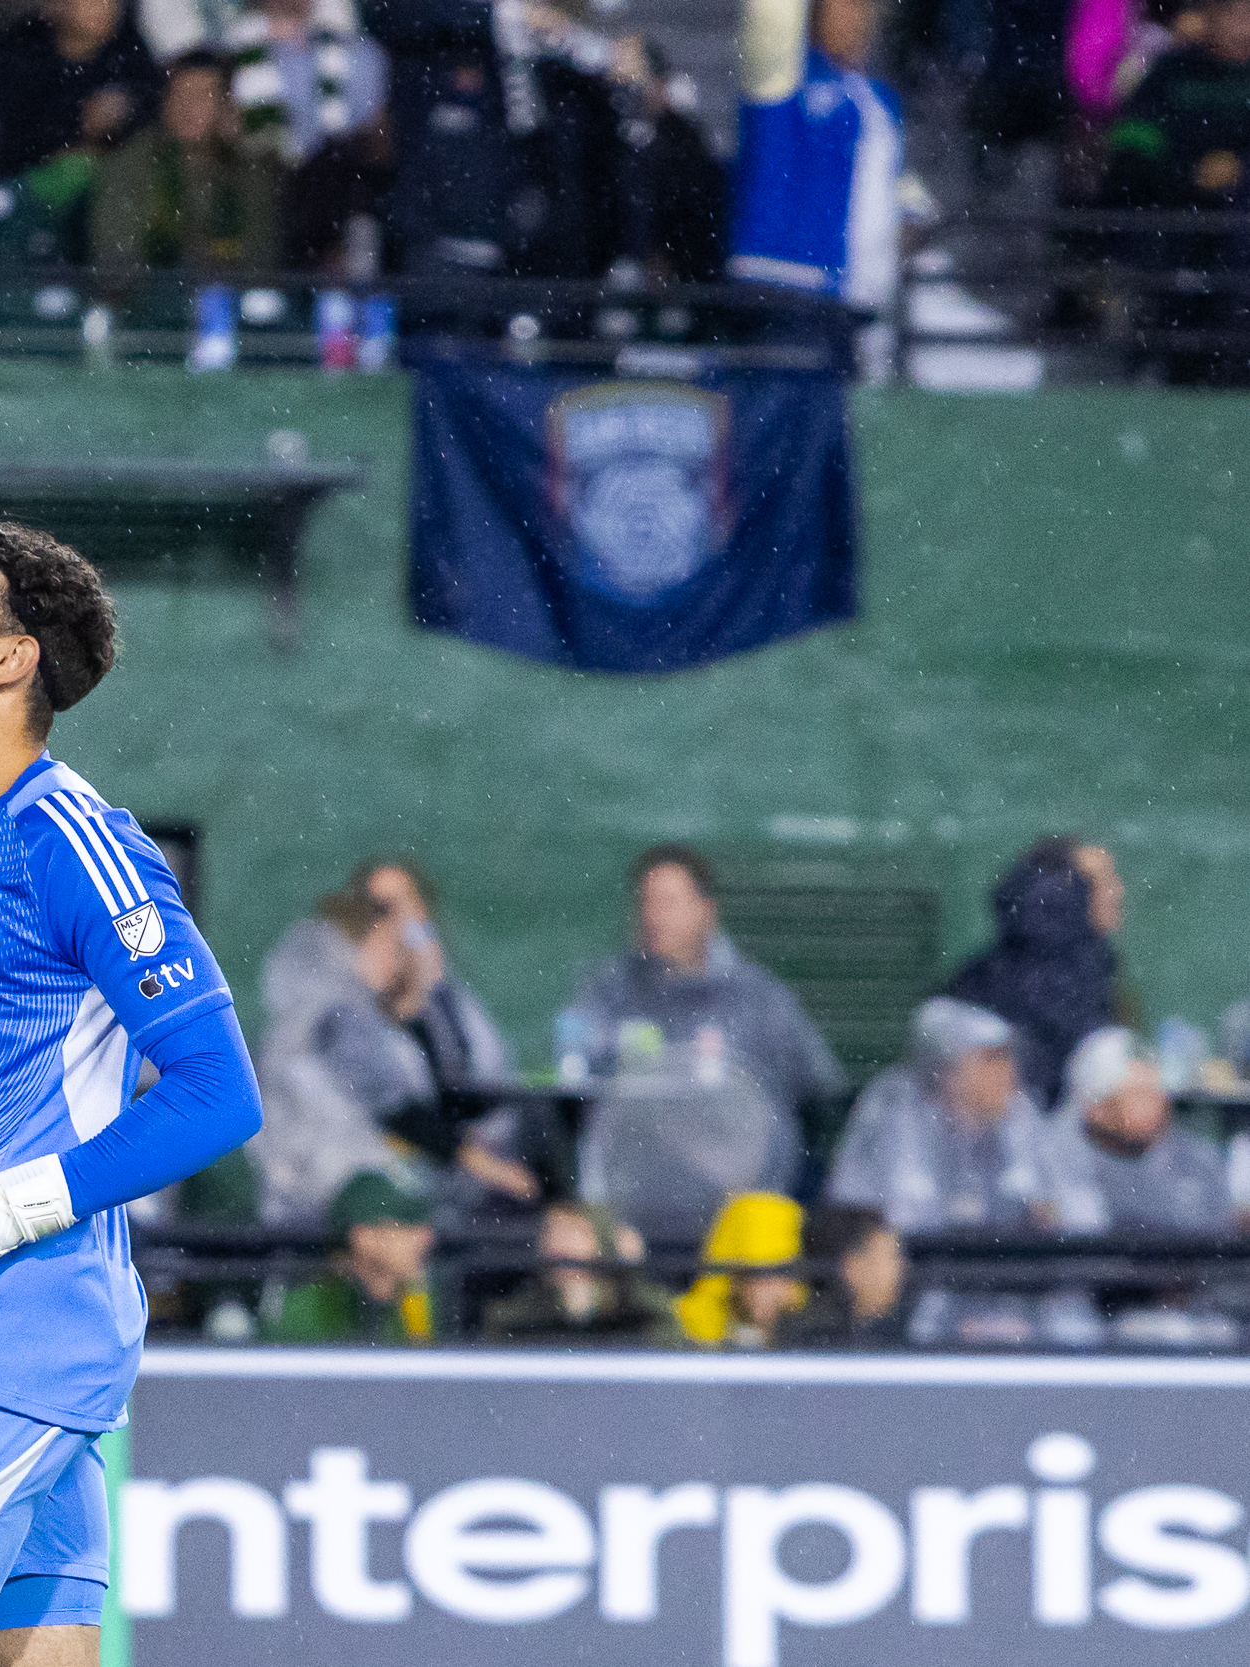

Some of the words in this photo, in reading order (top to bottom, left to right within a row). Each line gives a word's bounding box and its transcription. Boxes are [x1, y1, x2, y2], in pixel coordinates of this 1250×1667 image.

[120, 914, 143, 931] MLS
[160, 957, 194, 987] tv
[117, 1431, 1250, 1667] nterpris
